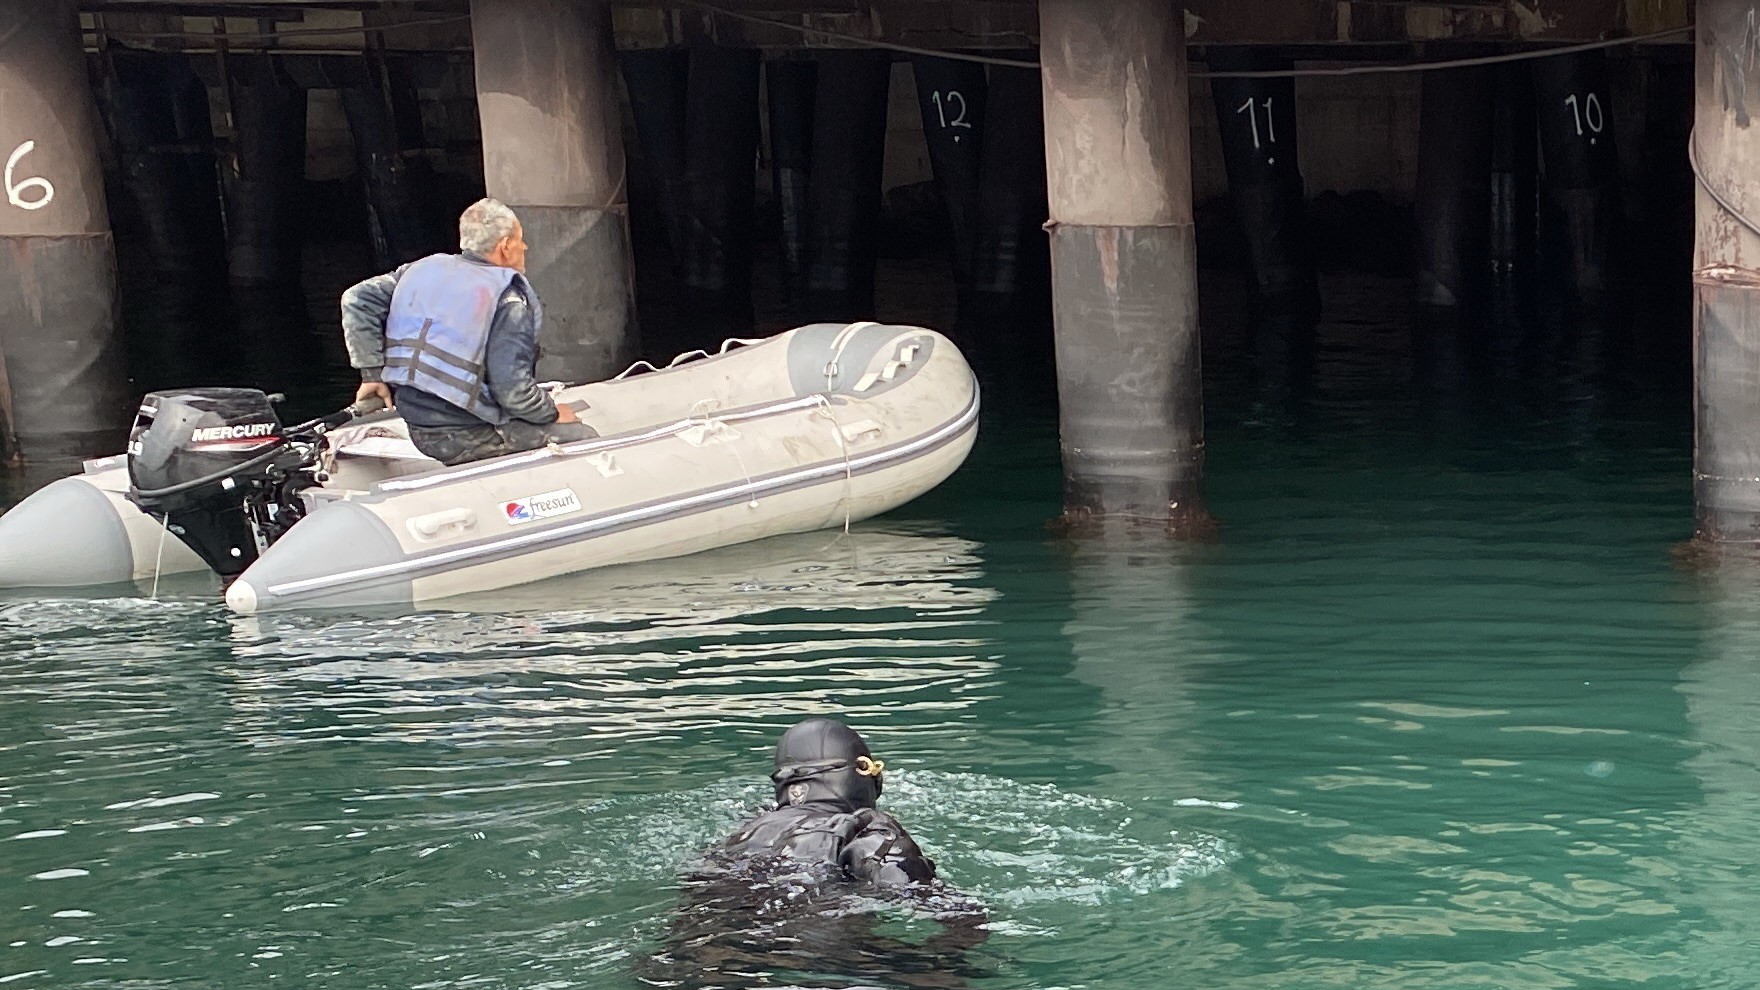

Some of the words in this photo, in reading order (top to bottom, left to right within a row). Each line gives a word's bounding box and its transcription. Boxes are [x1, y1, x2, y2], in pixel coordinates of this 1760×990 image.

[932, 91, 971, 129] 12
[1565, 93, 1604, 136] 10
[4, 140, 54, 210] 6
[192, 423, 276, 442] MERCURY
[529, 494, 575, 520] freesun
